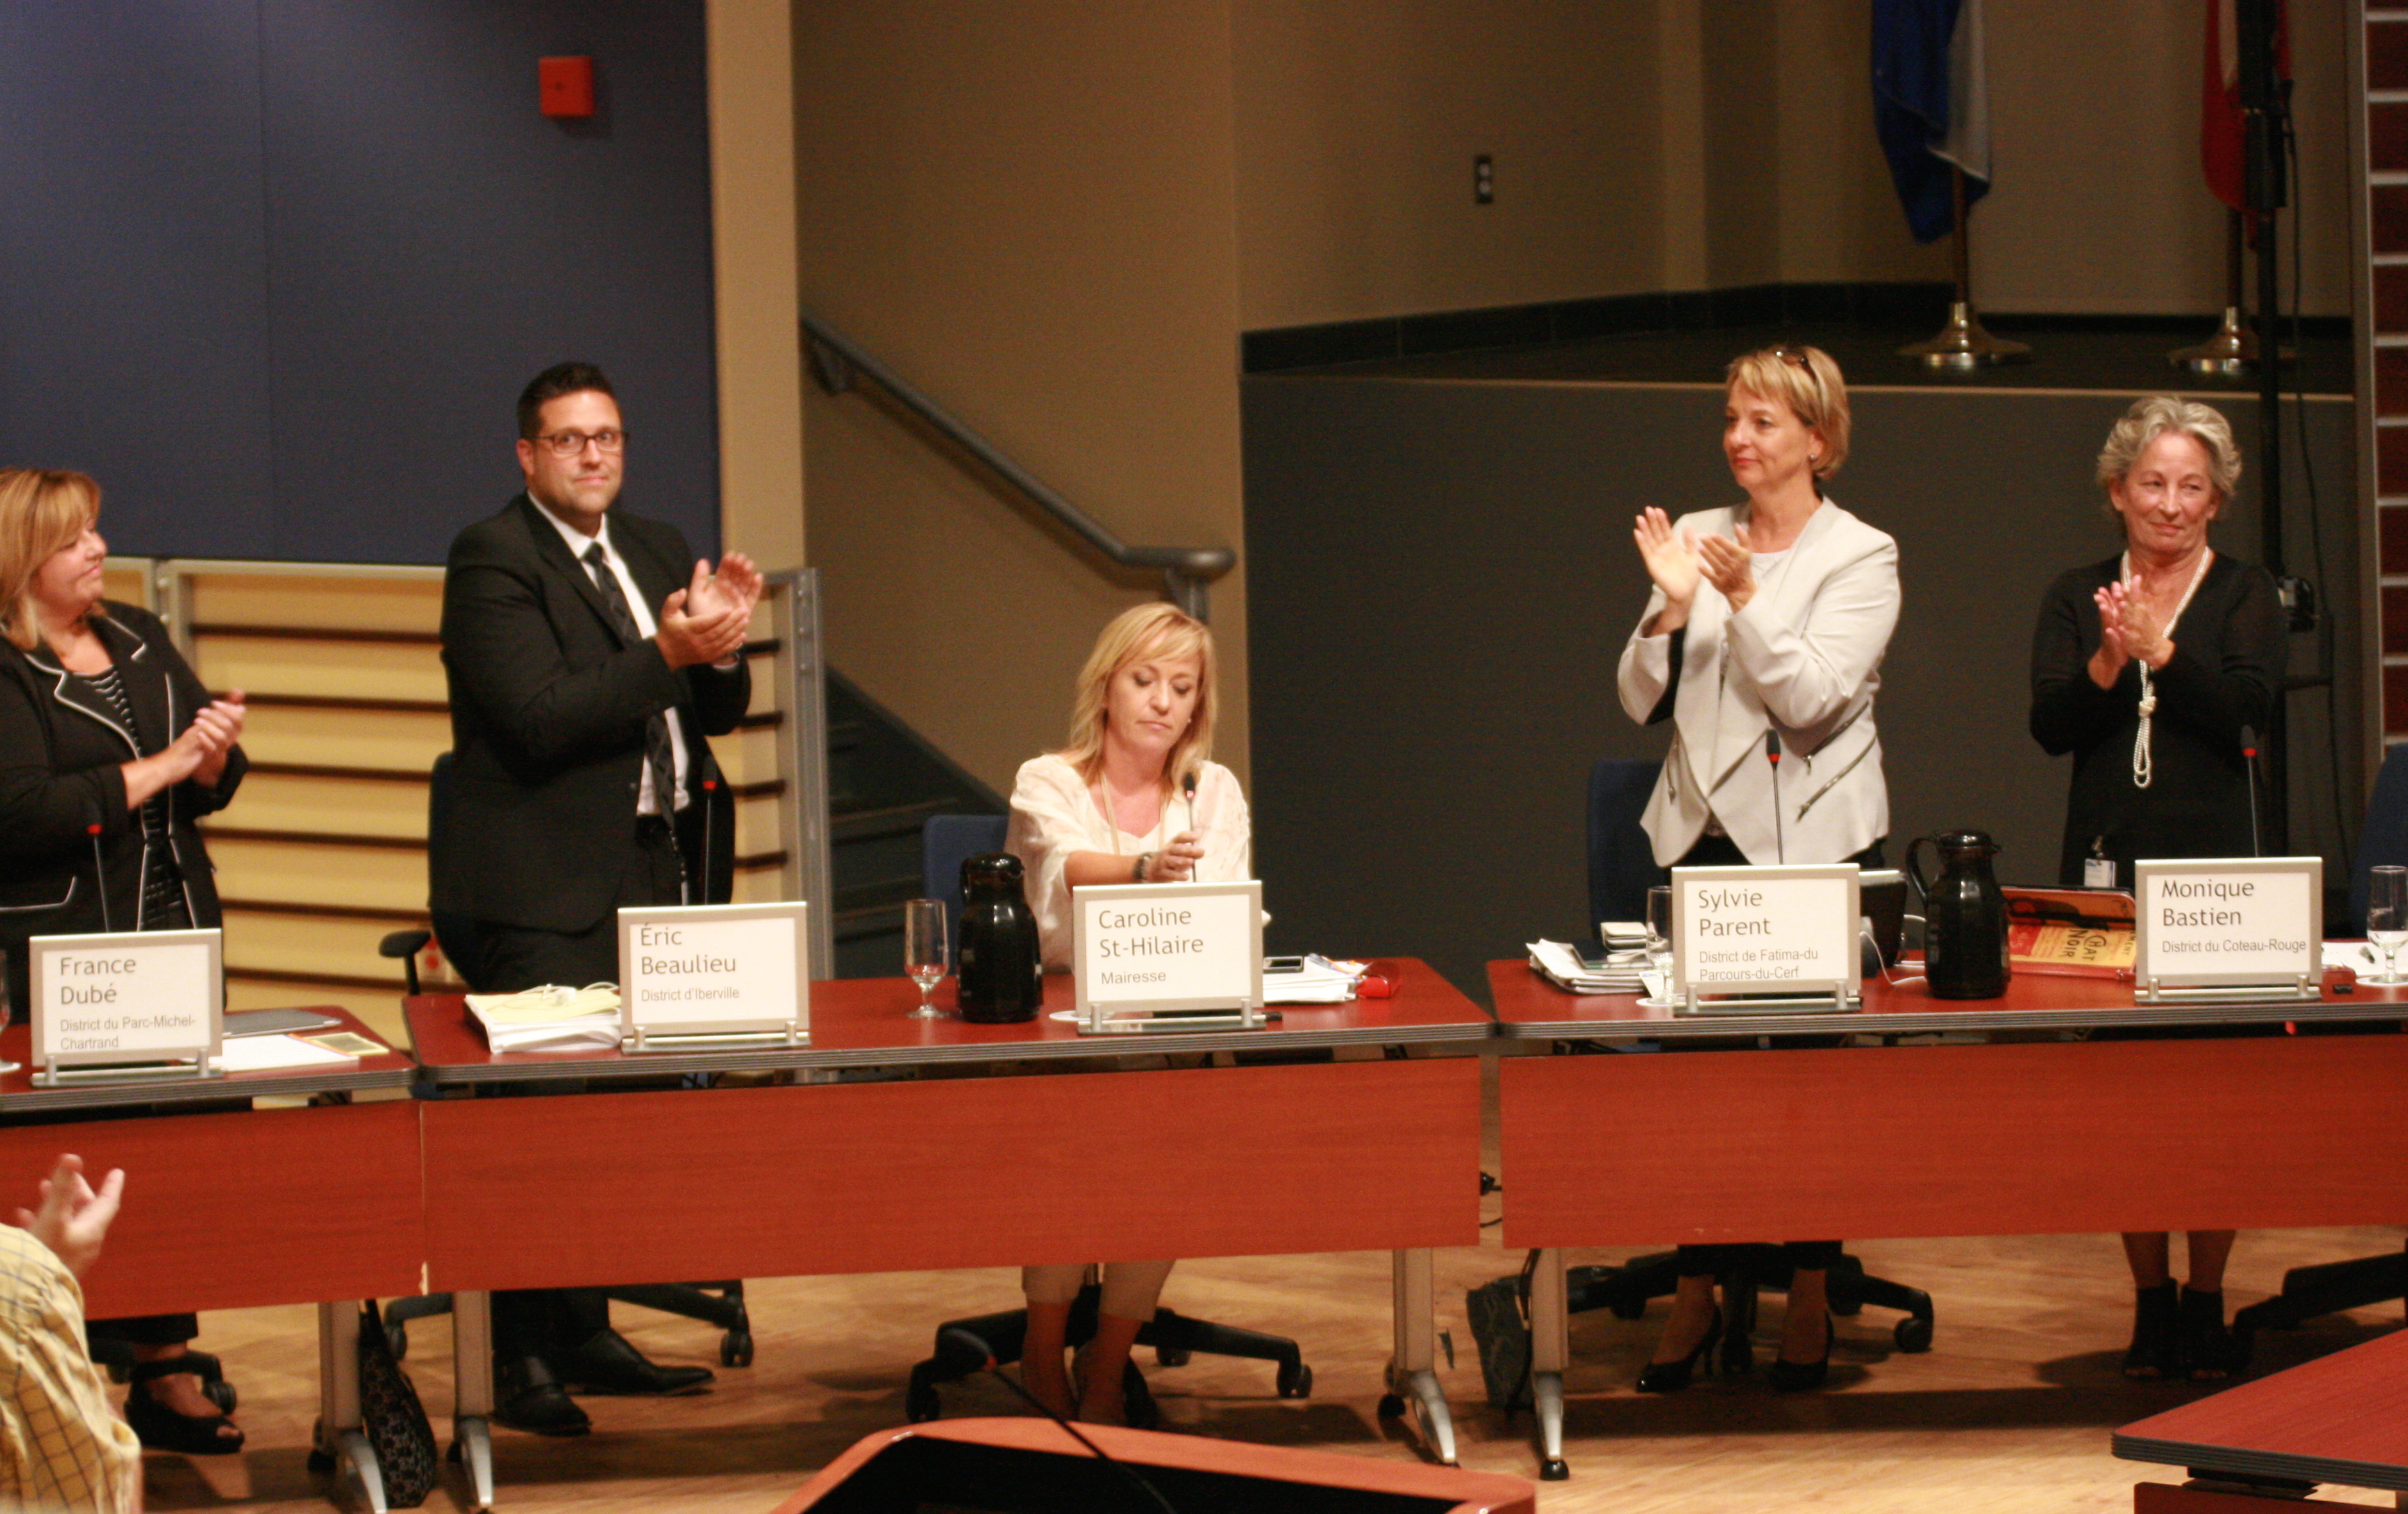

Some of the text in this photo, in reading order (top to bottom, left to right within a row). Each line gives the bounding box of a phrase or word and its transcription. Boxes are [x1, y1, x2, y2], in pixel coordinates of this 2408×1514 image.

[2161, 879, 2254, 901] Monique
[1698, 888, 1762, 913] Sylvie
[1098, 907, 1191, 929] Caroline
[2163, 907, 2241, 926] Bastien
[641, 922, 682, 946] Éric
[1700, 918, 1771, 936] Parent
[1099, 935, 1203, 957] St-Hilaire
[2059, 929, 2087, 957] NOIR
[2082, 934, 2107, 961] CHAT
[2162, 938, 2307, 953] District du Coteau-Rouge
[641, 954, 735, 975] Beaulieu
[1699, 947, 1818, 963] District de Fatima-du
[60, 957, 136, 975] France
[1700, 966, 1799, 981] Parcours-du-Cerf
[1101, 971, 1166, 984] Mairesse
[60, 982, 117, 1005] Dubé
[641, 986, 739, 1002] District d'Iberville
[60, 1014, 195, 1032] District du Parc-Michel-
[60, 1036, 119, 1050] Chartrand
